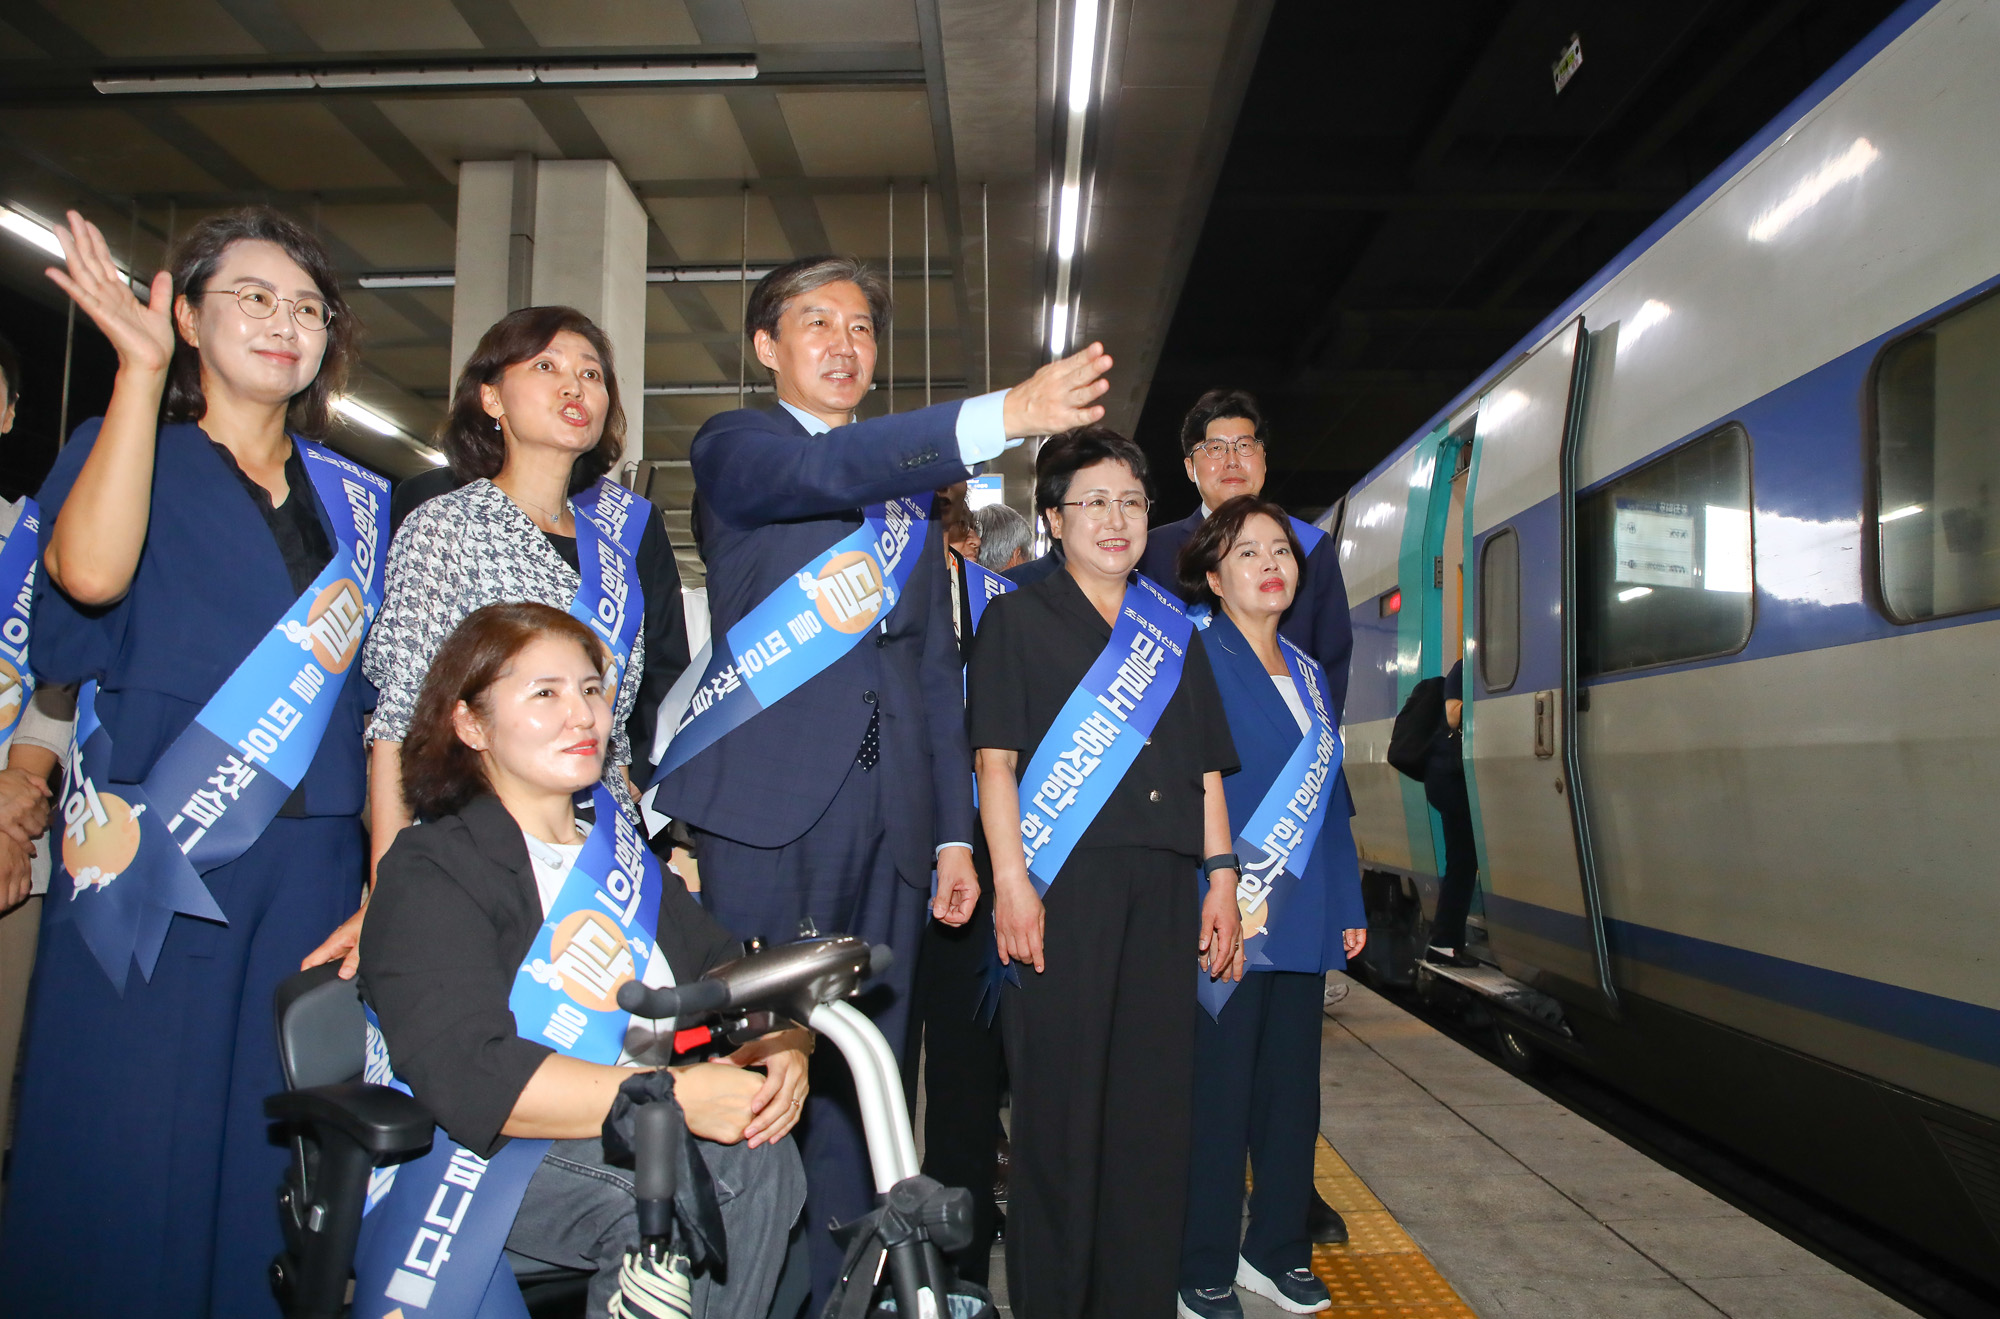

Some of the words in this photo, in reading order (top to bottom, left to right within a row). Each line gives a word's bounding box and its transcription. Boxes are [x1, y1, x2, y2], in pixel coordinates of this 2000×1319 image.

[342, 478, 379, 595] 탄핵의
[590, 538, 629, 645] 탄핵의
[1123, 606, 1184, 657] 조국혁신당
[1096, 631, 1165, 722] 마음도
[1032, 710, 1122, 820] 풍성한
[1286, 726, 1335, 823] 풍성한
[594, 809, 646, 928] 탄핵의
[1237, 816, 1304, 915] 한가위
